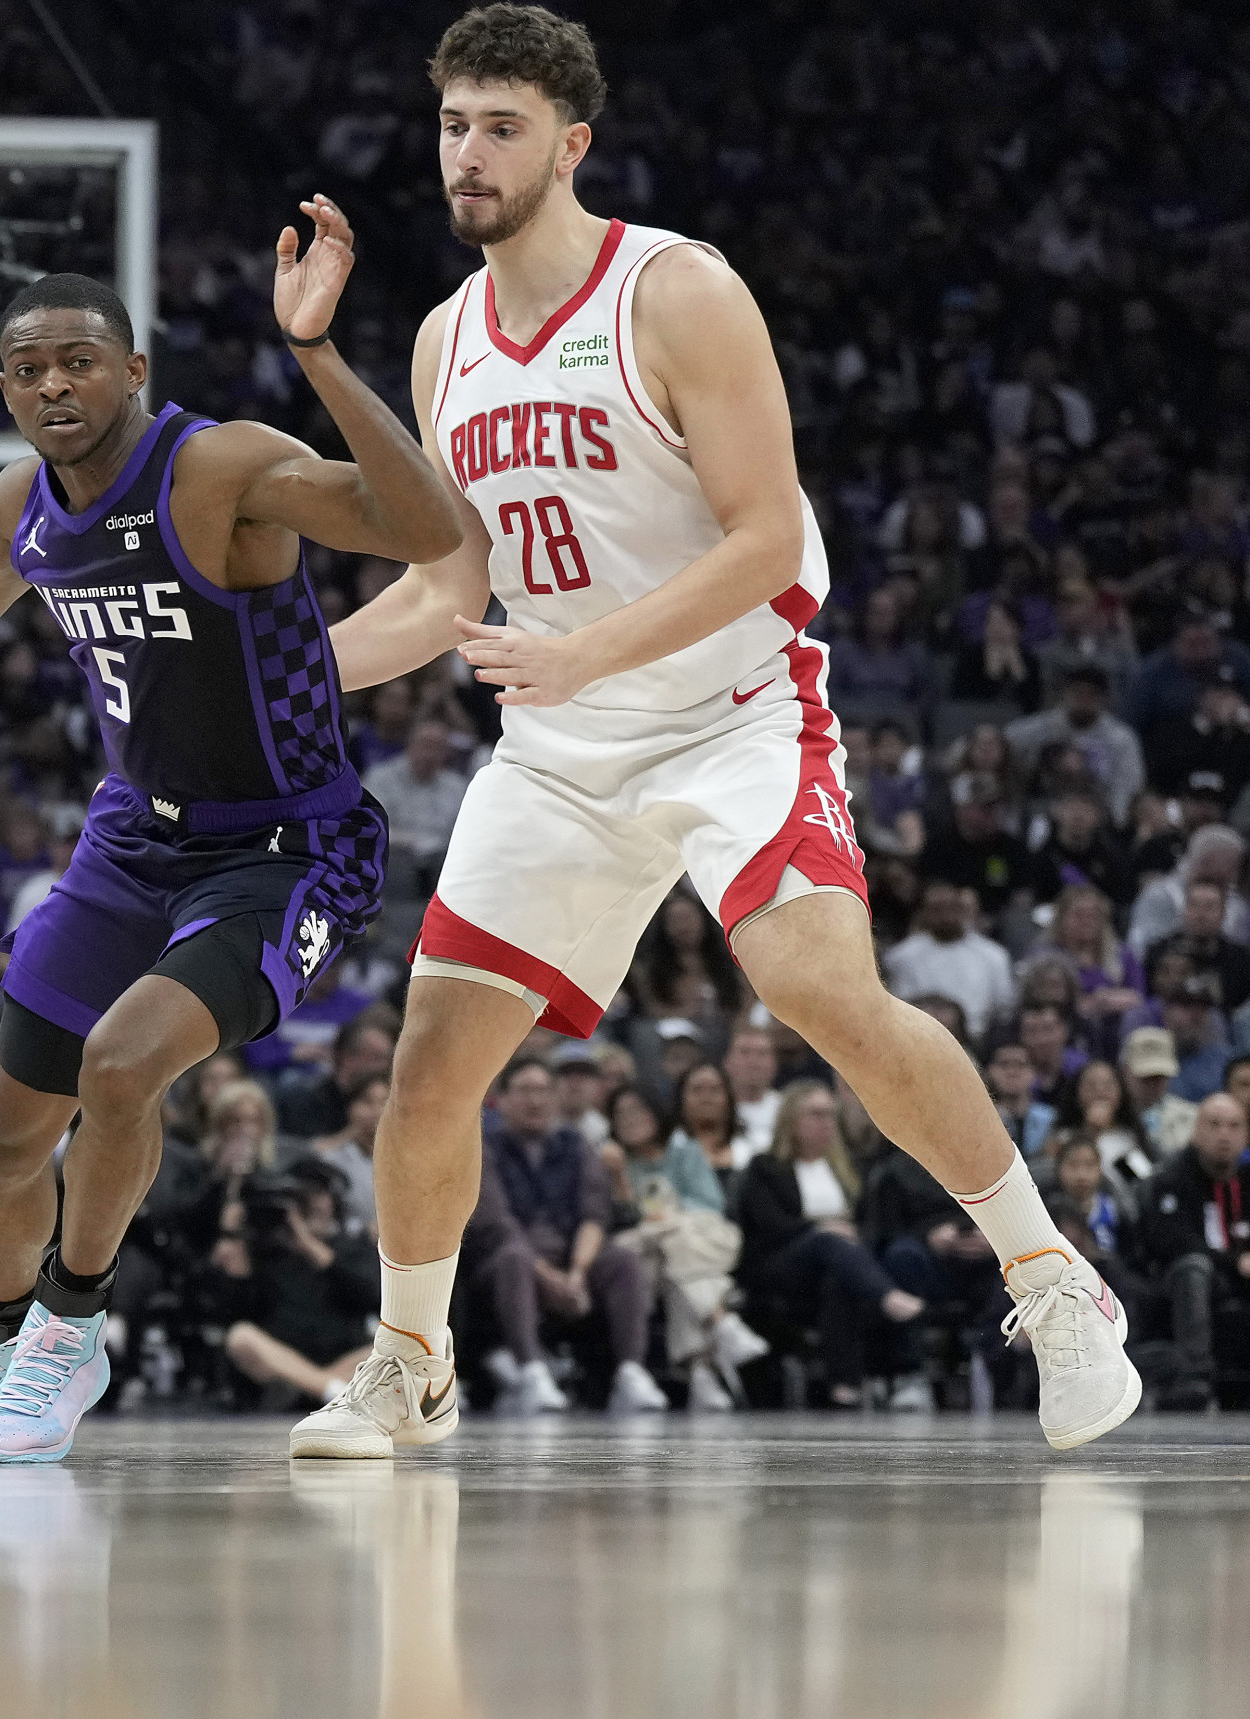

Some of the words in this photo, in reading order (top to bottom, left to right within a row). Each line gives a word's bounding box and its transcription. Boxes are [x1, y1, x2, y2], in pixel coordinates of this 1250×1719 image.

[562, 335, 609, 352] credit
[559, 352, 609, 370] karma
[450, 401, 619, 495] ROCKETS
[105, 509, 155, 531] dialpad
[498, 495, 592, 594] 28
[51, 585, 136, 599] SACRAMENTO
[91, 646, 131, 724] 5
